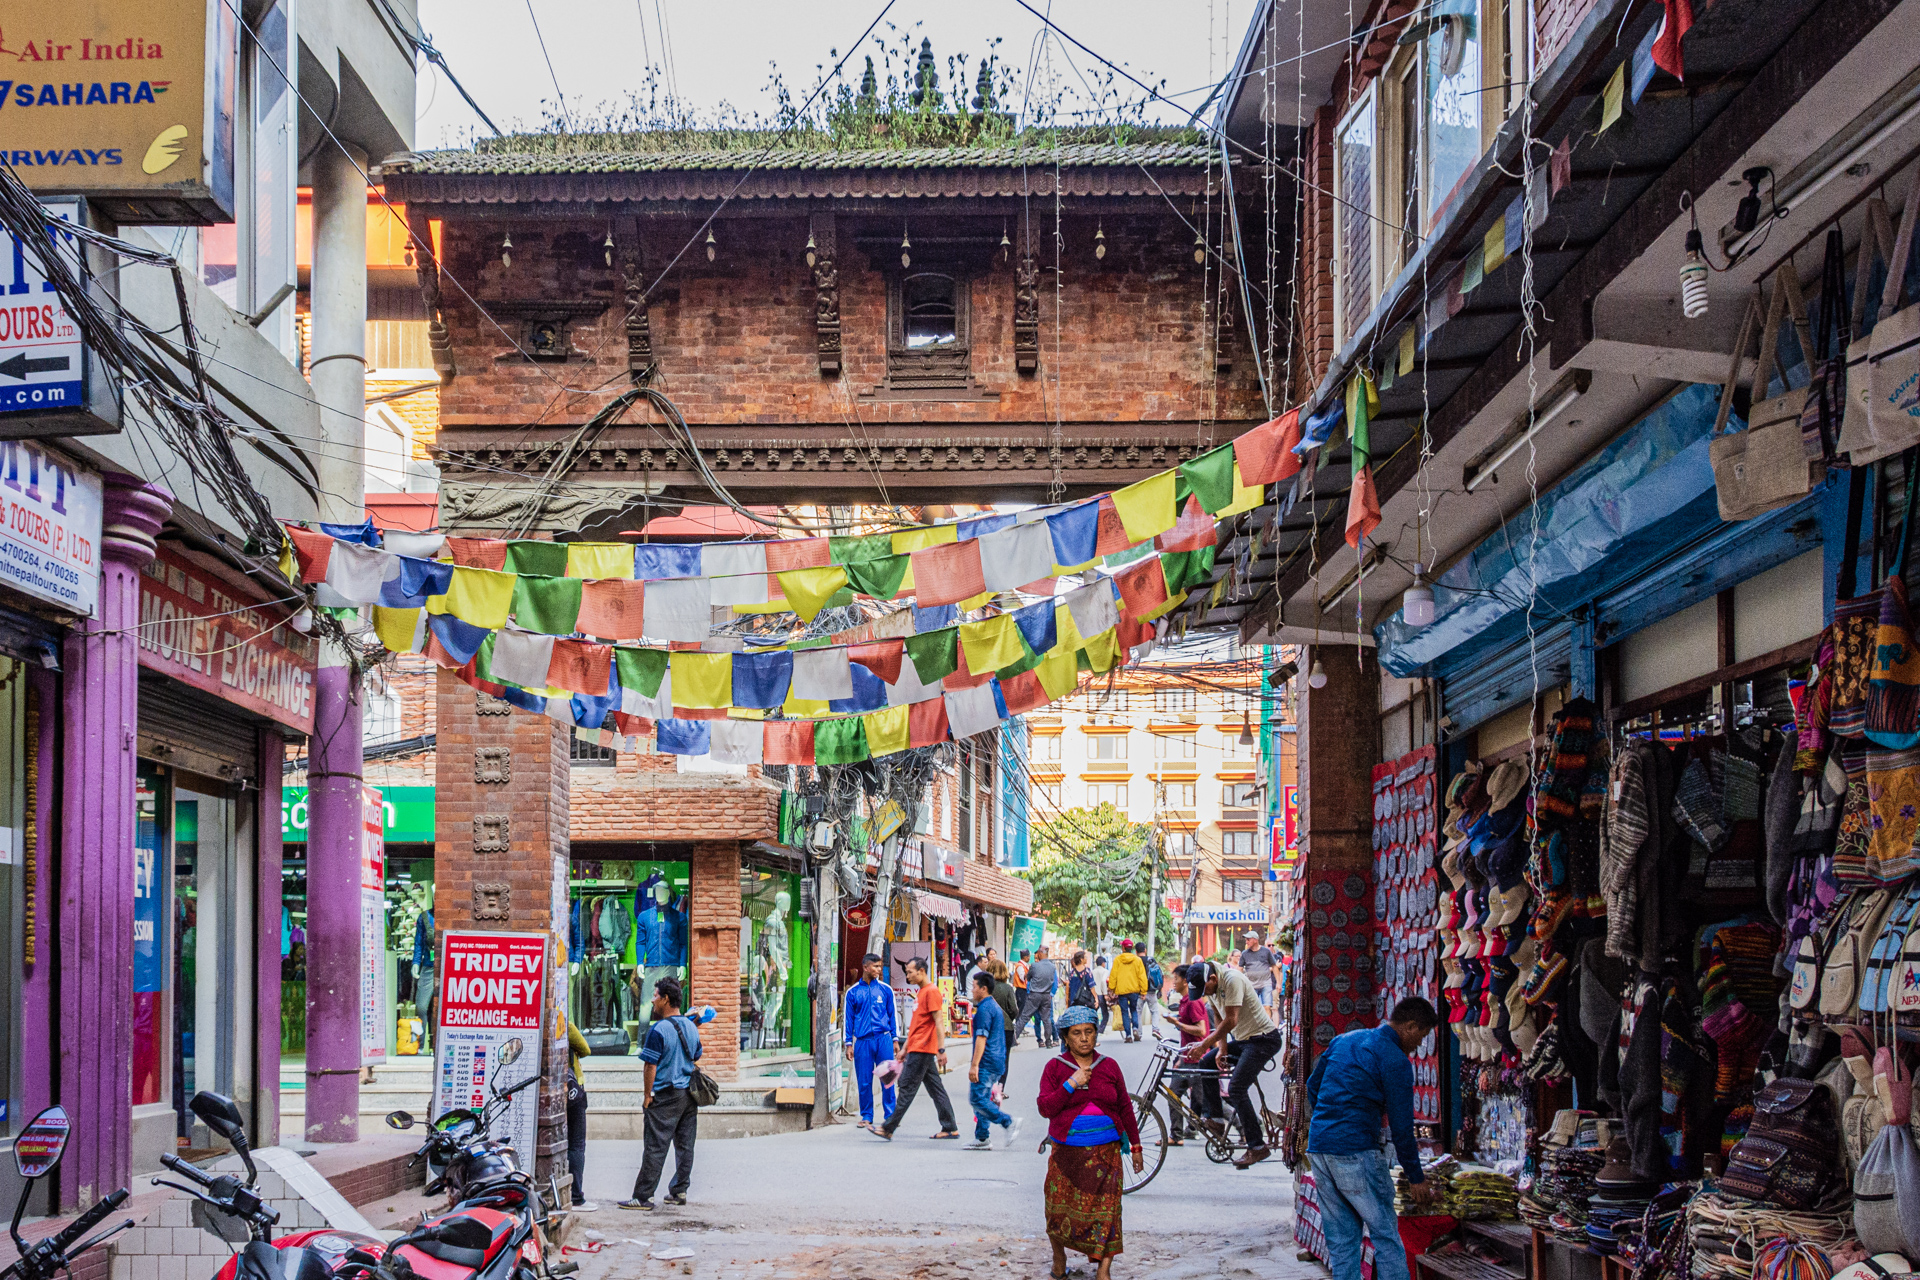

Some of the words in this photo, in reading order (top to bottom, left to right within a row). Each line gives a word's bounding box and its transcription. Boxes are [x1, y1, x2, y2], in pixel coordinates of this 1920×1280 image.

[18, 39, 72, 62] Air
[78, 37, 164, 61] India
[14, 81, 155, 107] SAHARA
[56, 325, 76, 337] LTD.
[10, 501, 50, 545] TOURS
[72, 533, 94, 567] LTD.
[44, 560, 79, 586] 4700265
[211, 588, 269, 634] TRIDEV
[140, 589, 219, 677] MONEY
[221, 631, 312, 719] EXCHANGE
[1208, 908, 1265, 921] vaishali
[450, 952, 541, 973] TRIDEV
[447, 977, 540, 1005] MONEY
[445, 1008, 508, 1026] EXCHANGE
[510, 1015, 523, 1026] Pvt.
[525, 1016, 538, 1027] Ltd.
[446, 1032, 459, 1041] Today's
[459, 1033, 476, 1041] Exchange
